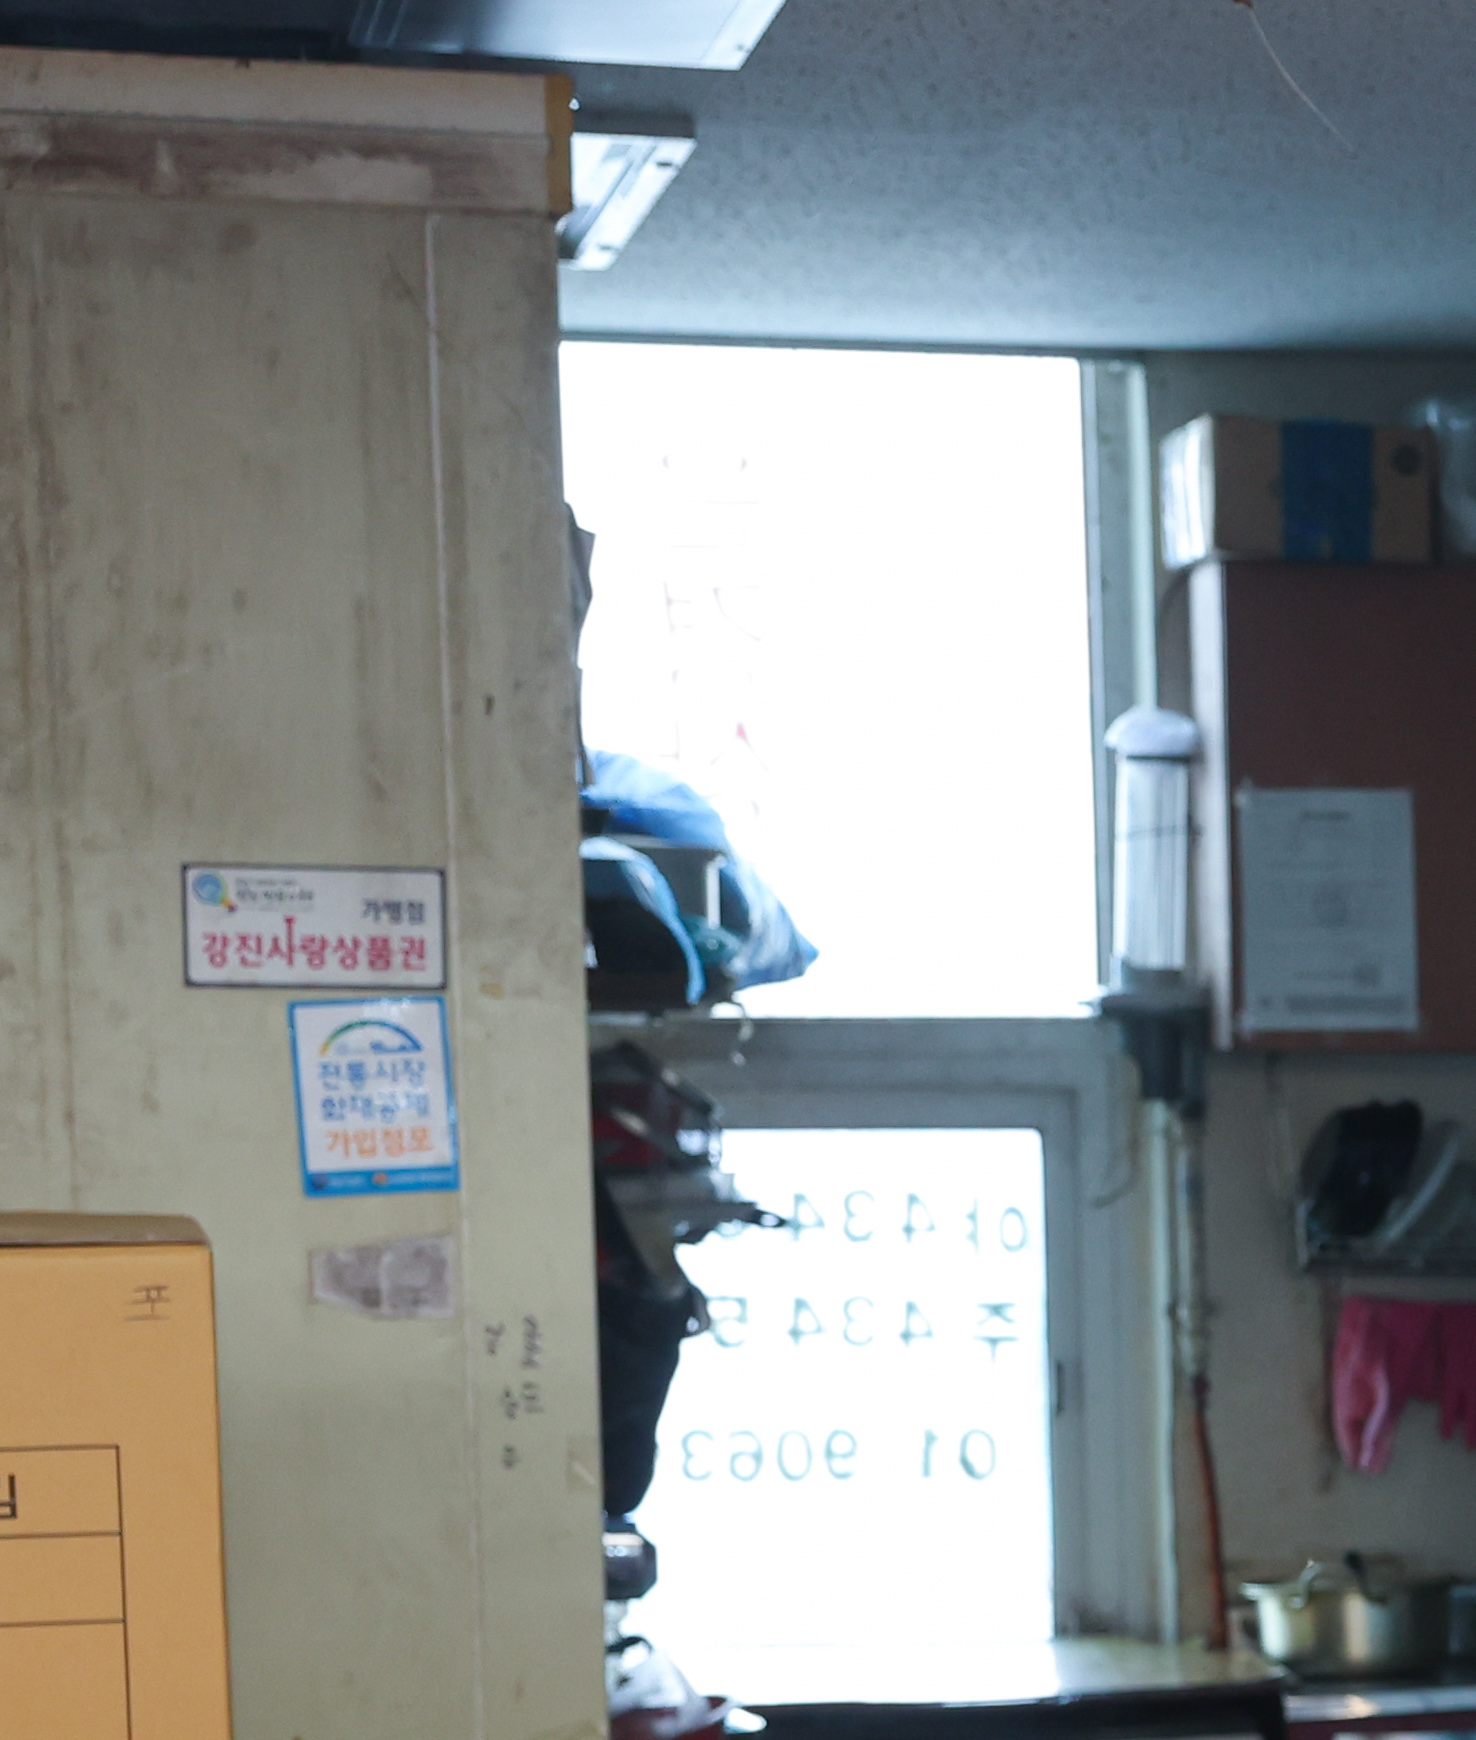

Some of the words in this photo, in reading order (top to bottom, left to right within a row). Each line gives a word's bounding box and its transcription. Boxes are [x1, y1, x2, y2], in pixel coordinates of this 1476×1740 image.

[361, 898, 426, 925] 가맹점
[201, 915, 428, 972] 강진사랑상품권
[318, 1060, 427, 1092] 전통시장
[324, 1126, 434, 1158] 가입점포
